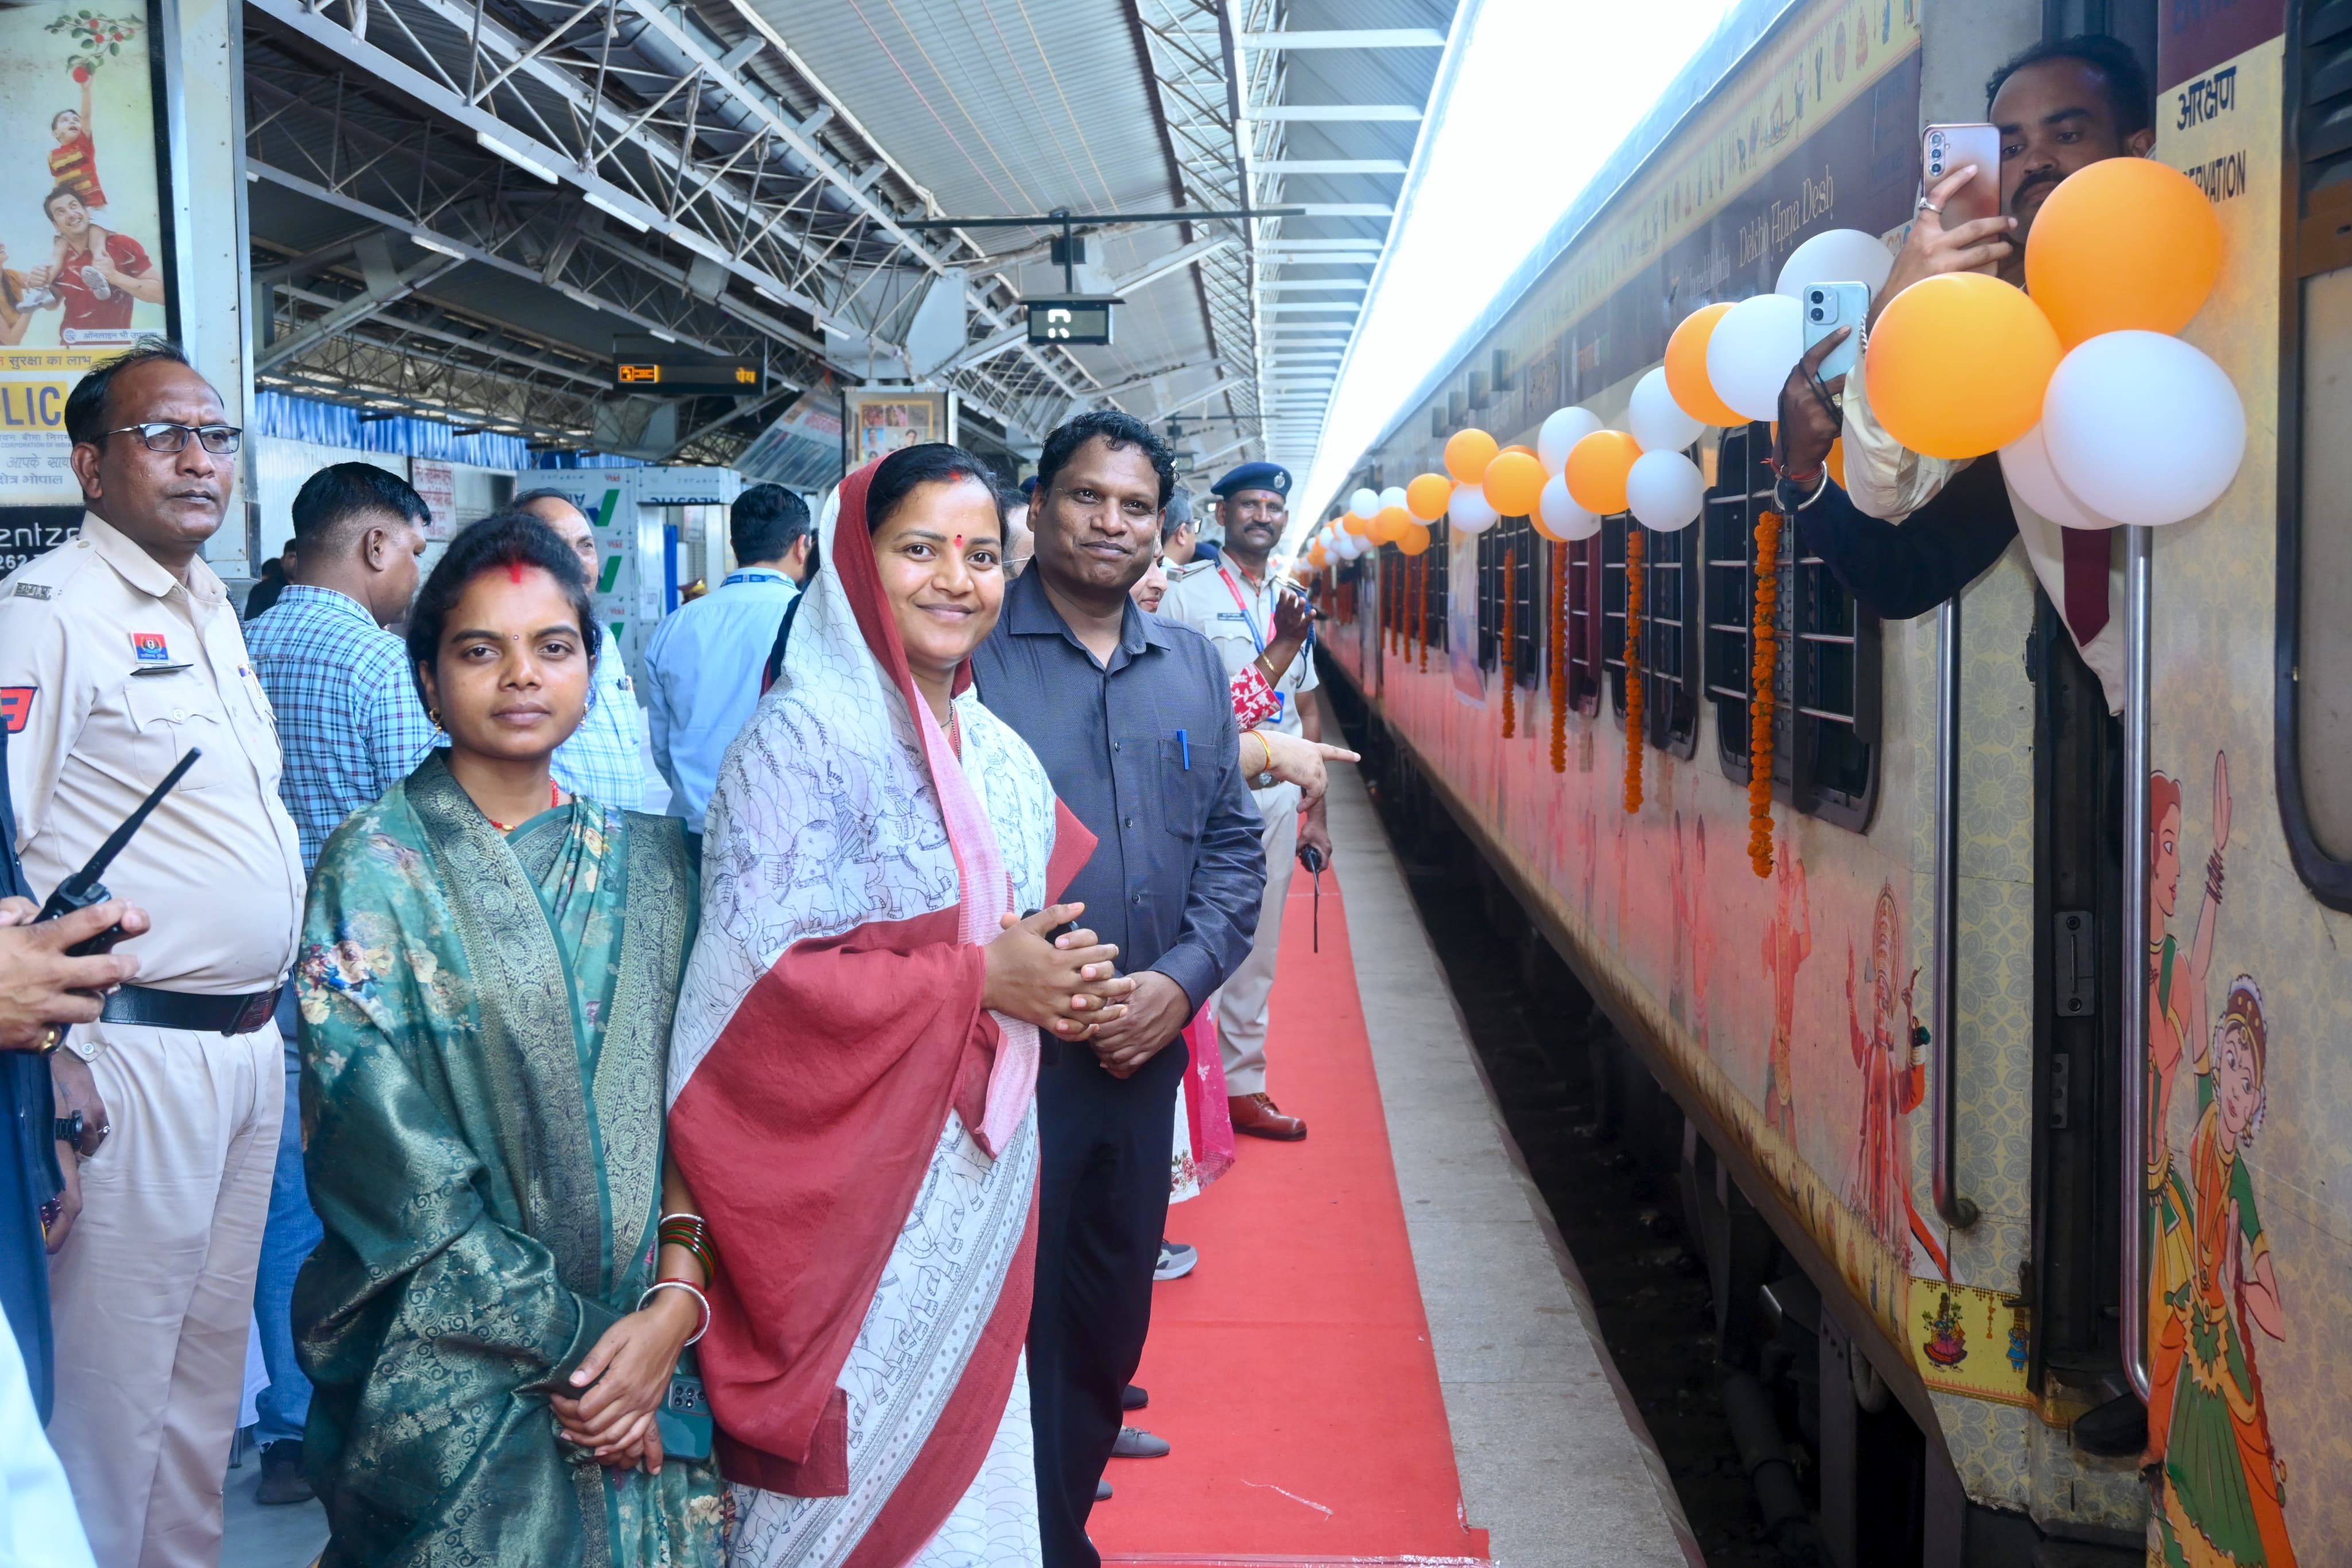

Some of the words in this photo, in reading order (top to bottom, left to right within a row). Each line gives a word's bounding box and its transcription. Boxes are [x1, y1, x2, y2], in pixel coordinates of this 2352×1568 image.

[2177, 65, 2237, 130] आरक्षण
[1739, 216, 1769, 268] Dekho
[1771, 199, 1799, 262] Apna
[1802, 164, 1833, 225] Desh
[9, 356, 42, 369] सुरक्षा
[47, 356, 62, 365] का
[67, 356, 92, 365] लाभ
[2, 386, 61, 426] LIC
[23, 473, 63, 485] भोपाल
